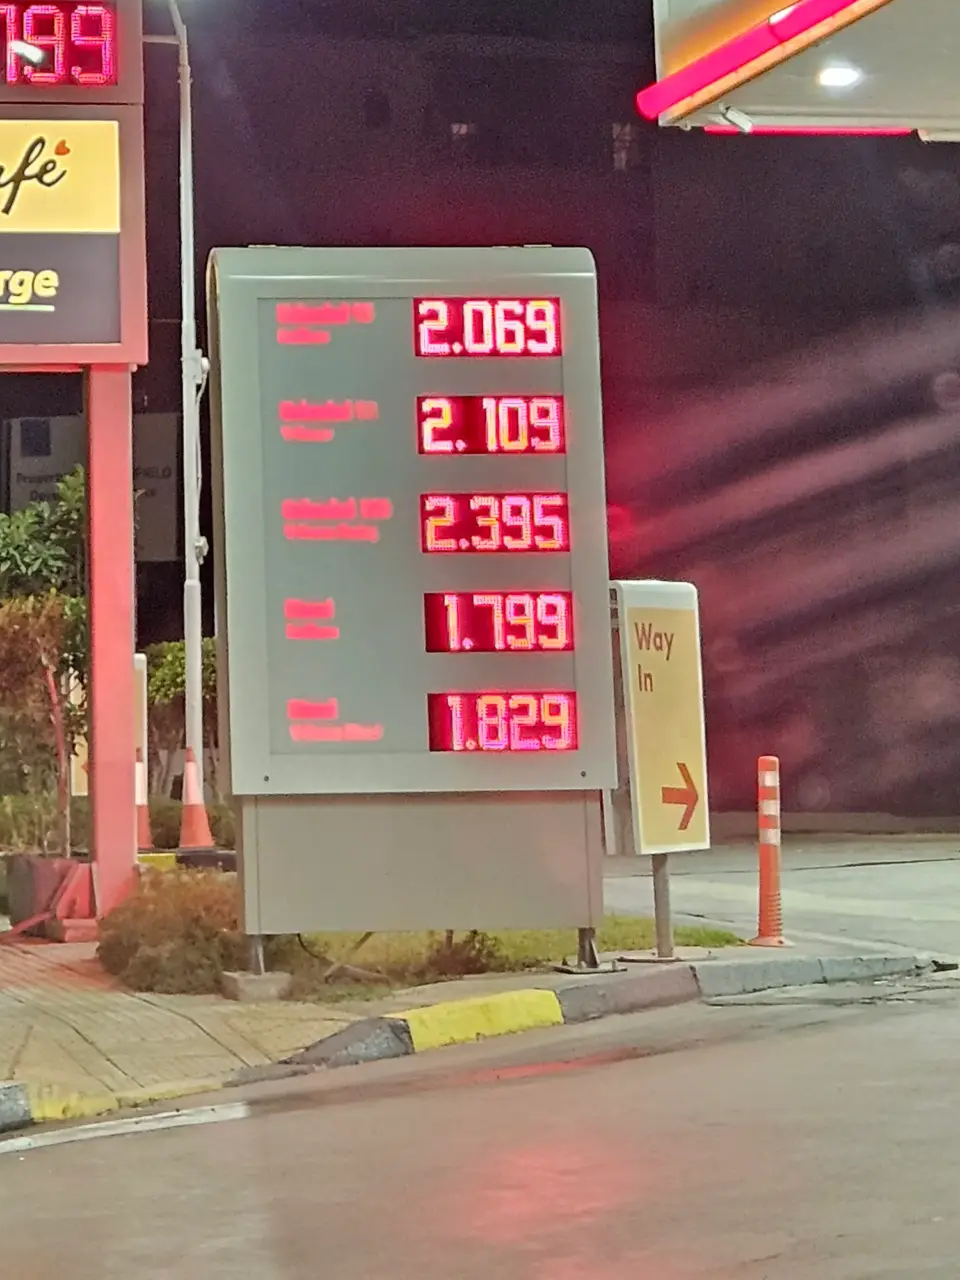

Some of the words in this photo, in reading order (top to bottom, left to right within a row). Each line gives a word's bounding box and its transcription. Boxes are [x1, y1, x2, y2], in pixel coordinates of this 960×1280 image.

[417, 300, 557, 356] 2.069
[421, 397, 561, 452] 2.109
[425, 495, 565, 550] 2.395
[444, 594, 569, 650] 1.799
[634, 622, 675, 661] Way
[638, 664, 654, 692] In
[447, 694, 571, 751] 1.829
